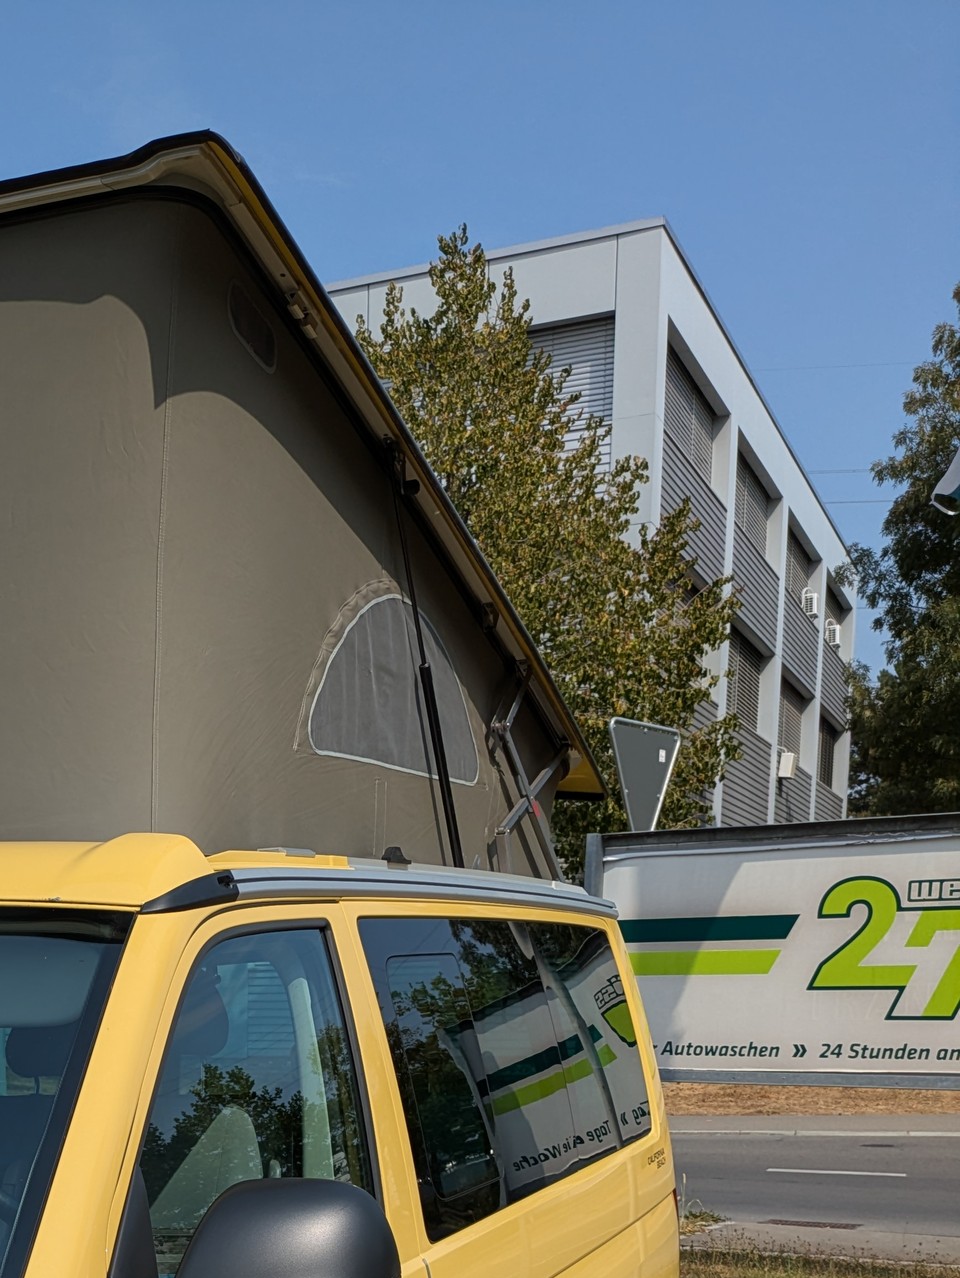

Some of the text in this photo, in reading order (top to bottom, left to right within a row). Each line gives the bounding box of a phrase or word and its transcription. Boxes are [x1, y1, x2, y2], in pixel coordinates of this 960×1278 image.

[661, 1041, 780, 1057] Autowaschen
[819, 1043, 843, 1058] 24
[848, 1043, 931, 1060] Stunden
